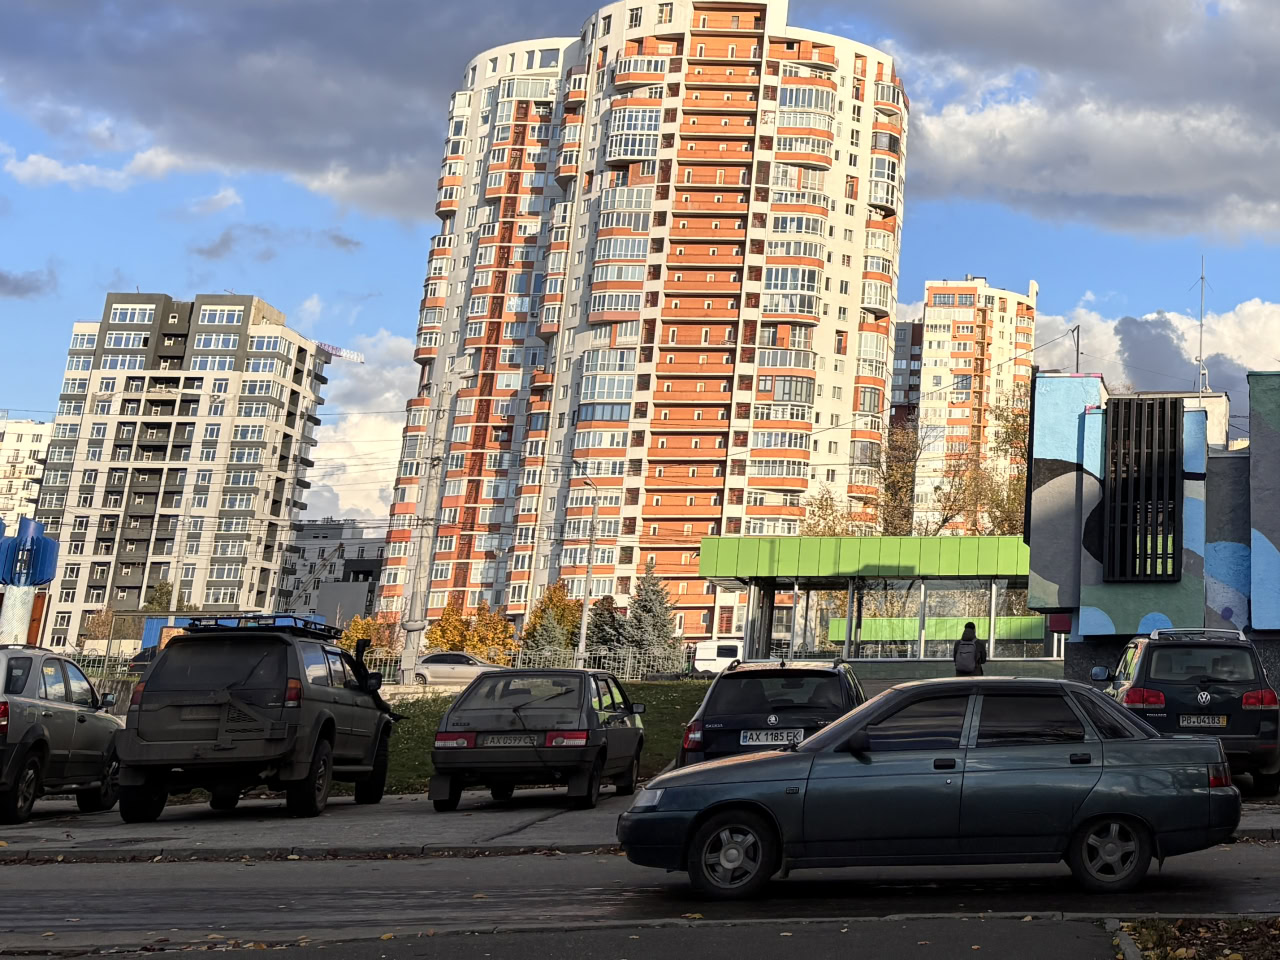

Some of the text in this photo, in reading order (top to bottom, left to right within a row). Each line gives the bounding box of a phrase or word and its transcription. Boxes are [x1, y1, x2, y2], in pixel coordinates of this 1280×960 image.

[490, 736, 501, 745] AX
[503, 736, 522, 744] 0599
[748, 731, 799, 741] AX 1185 EK
